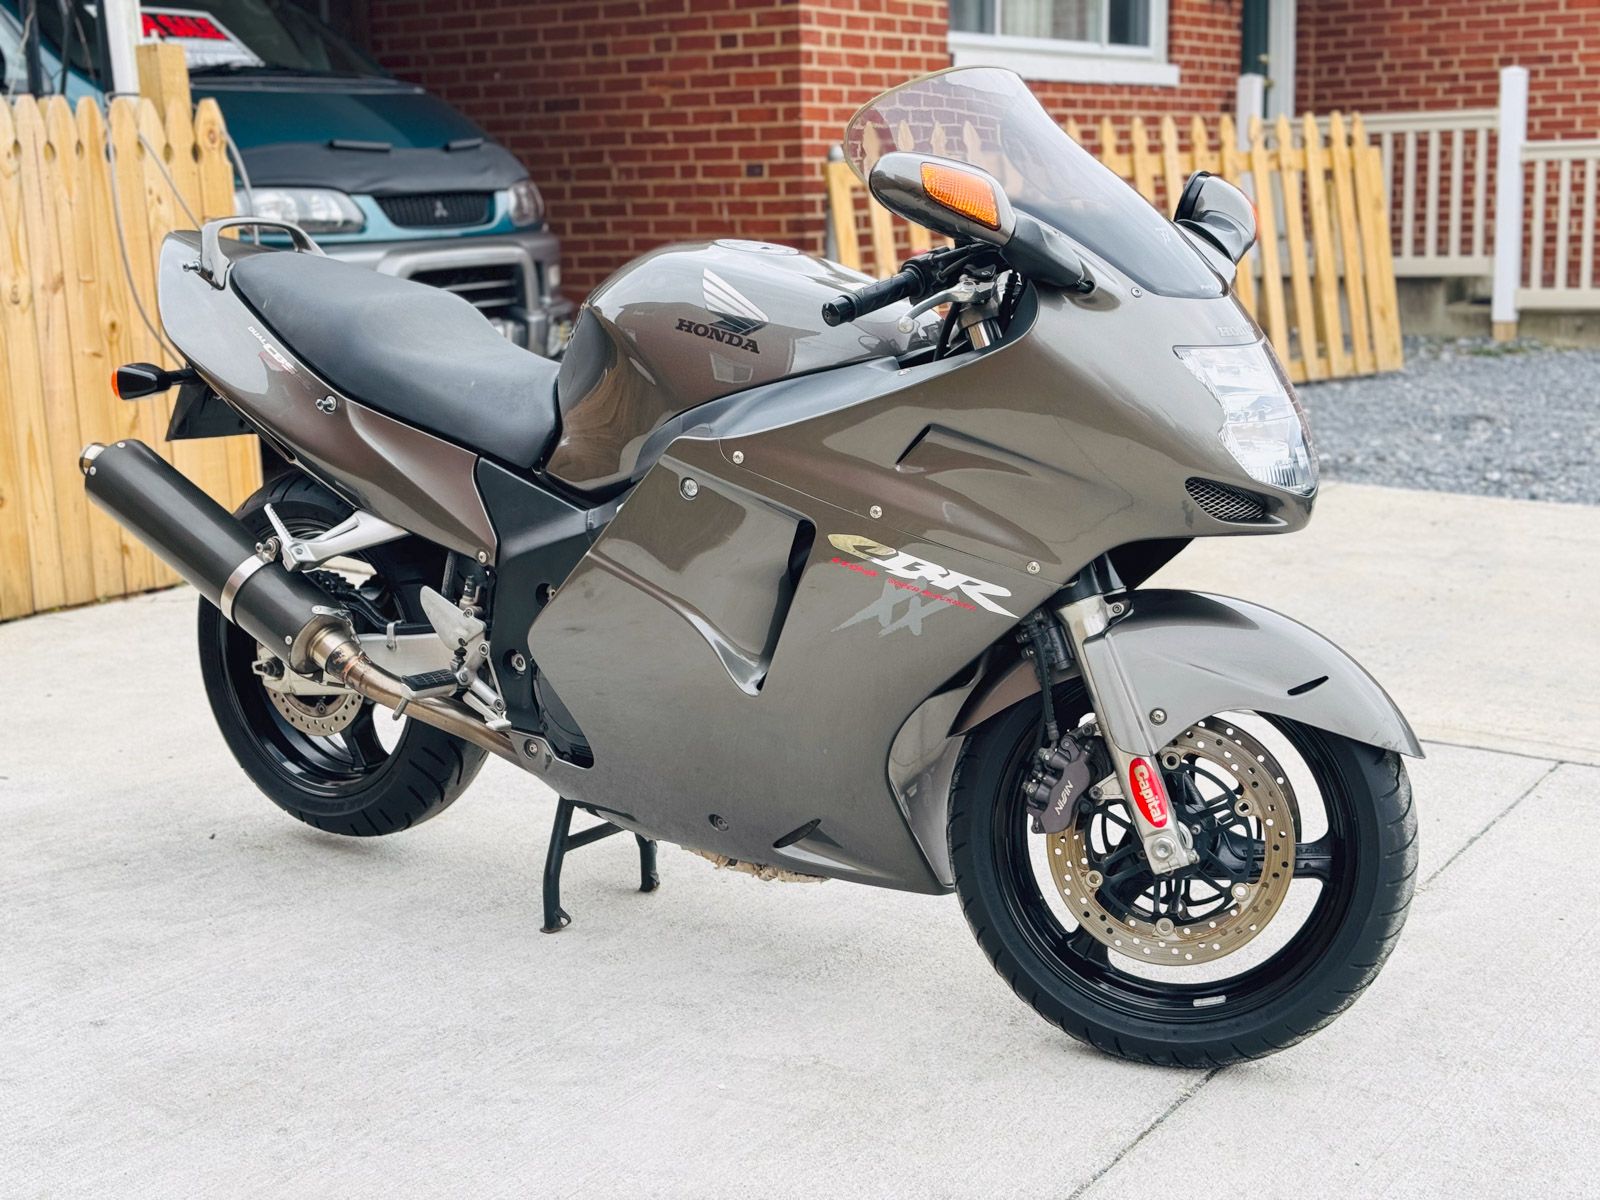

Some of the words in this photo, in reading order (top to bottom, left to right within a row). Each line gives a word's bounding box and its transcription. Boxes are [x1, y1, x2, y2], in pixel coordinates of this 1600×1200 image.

[675, 318, 760, 354] HONDA
[828, 534, 1020, 619] CBR
[831, 576, 958, 638] XX
[1134, 765, 1167, 823] Capital
